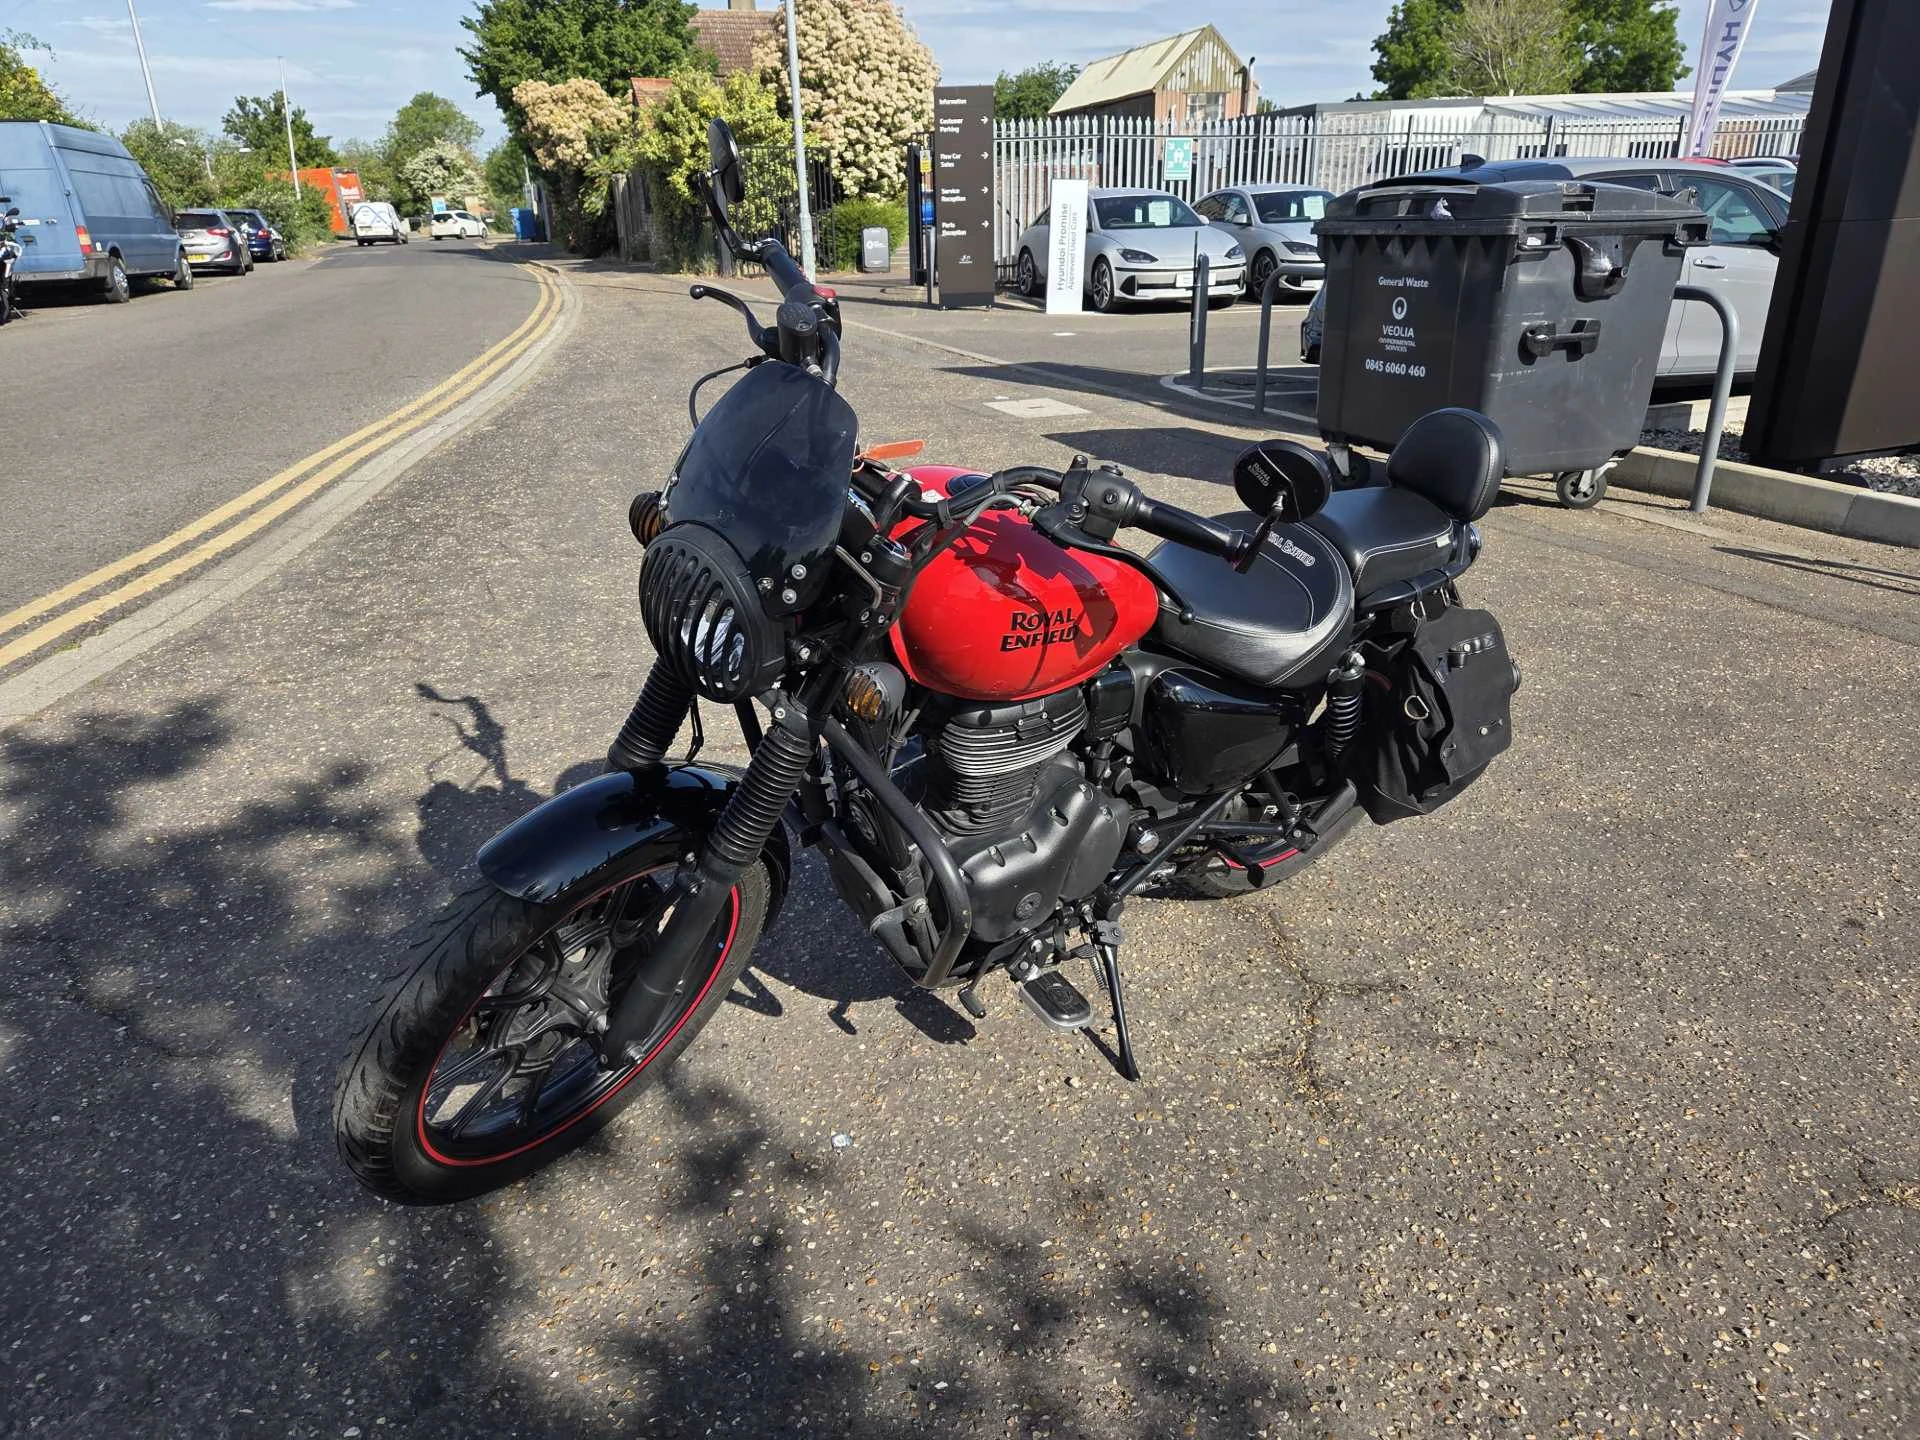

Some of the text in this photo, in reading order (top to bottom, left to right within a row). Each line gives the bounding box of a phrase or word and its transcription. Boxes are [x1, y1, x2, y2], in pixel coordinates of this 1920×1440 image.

[1056, 203, 1068, 291] Hyundai Promise
[1378, 276, 1430, 288] General Waste
[1382, 324, 1415, 338] VEOLIA
[1365, 358, 1426, 378] 0845 6060 460
[1010, 607, 1076, 632] ROYAL
[1000, 623, 1080, 652] ENFIELD
